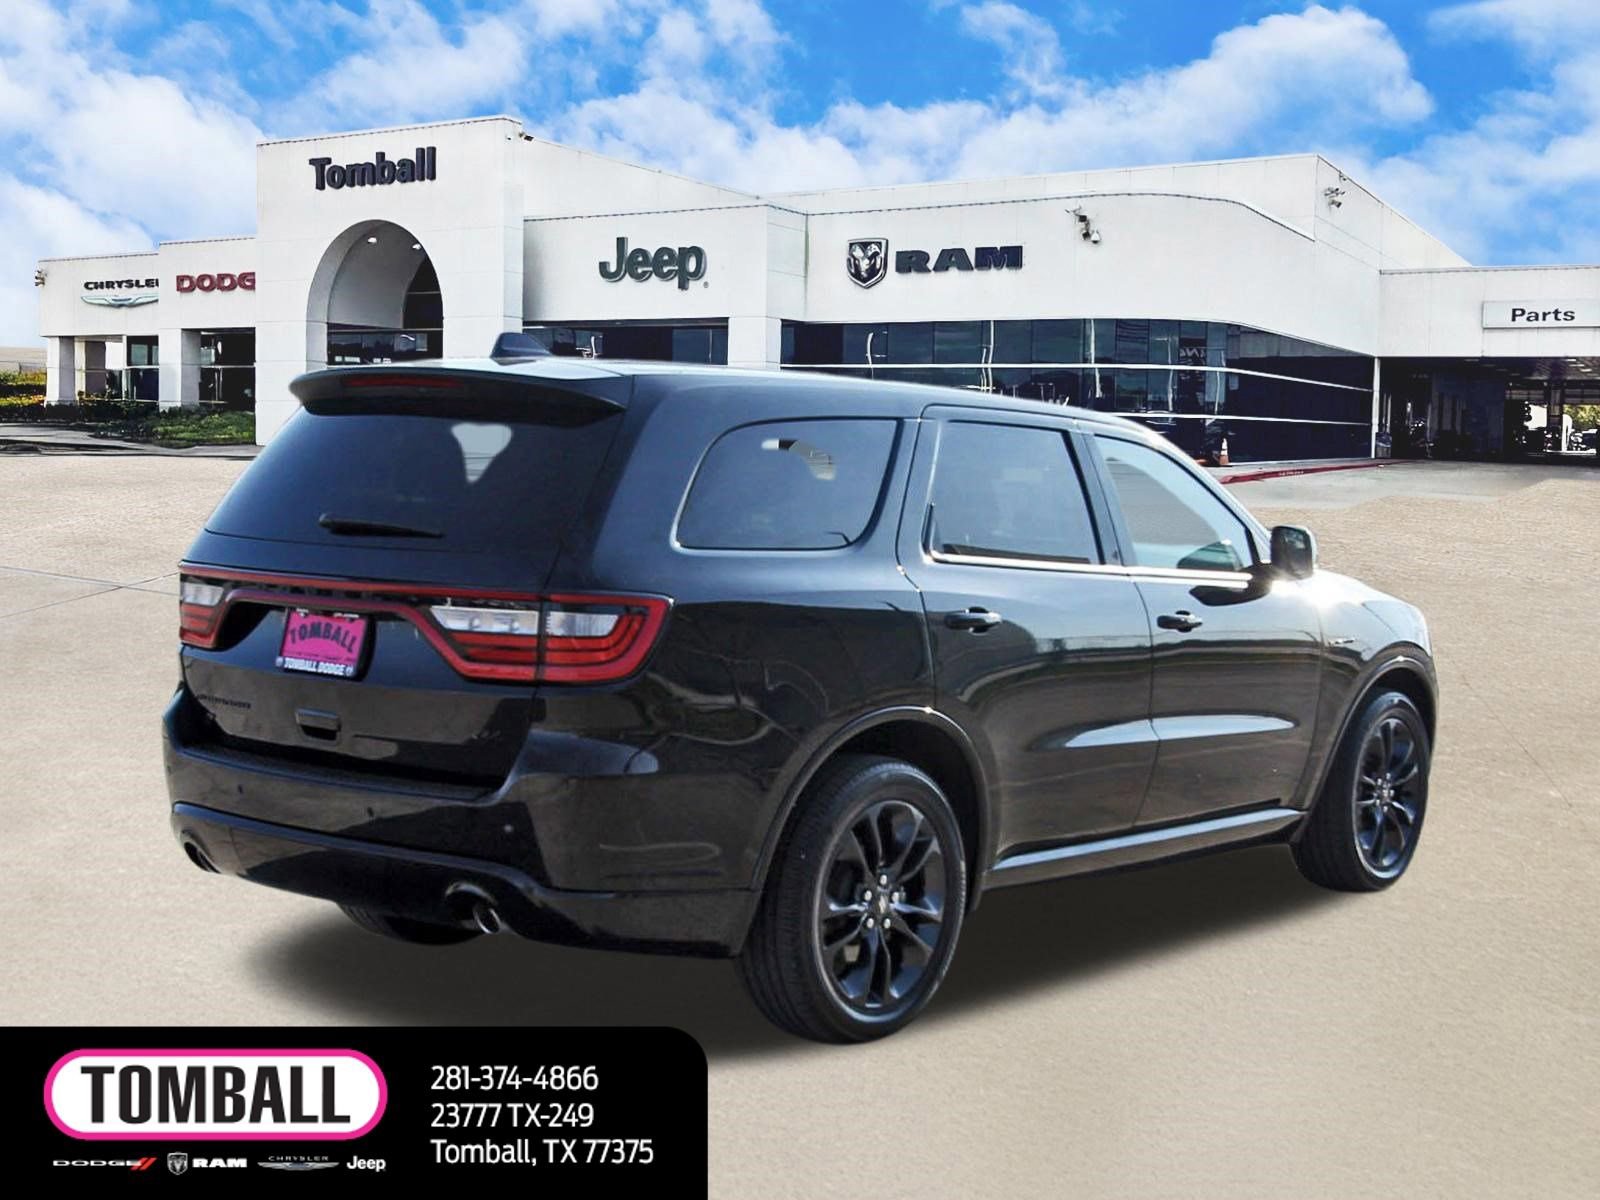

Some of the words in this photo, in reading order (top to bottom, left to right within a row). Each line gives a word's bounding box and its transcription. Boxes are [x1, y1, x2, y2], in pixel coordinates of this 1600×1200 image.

[308, 145, 436, 191] Tomball
[598, 236, 707, 291] Jeep
[895, 245, 1024, 274] RAM
[1511, 307, 1576, 322] Parts
[290, 621, 357, 653] TOMBALL
[284, 657, 317, 672] TOMBALL
